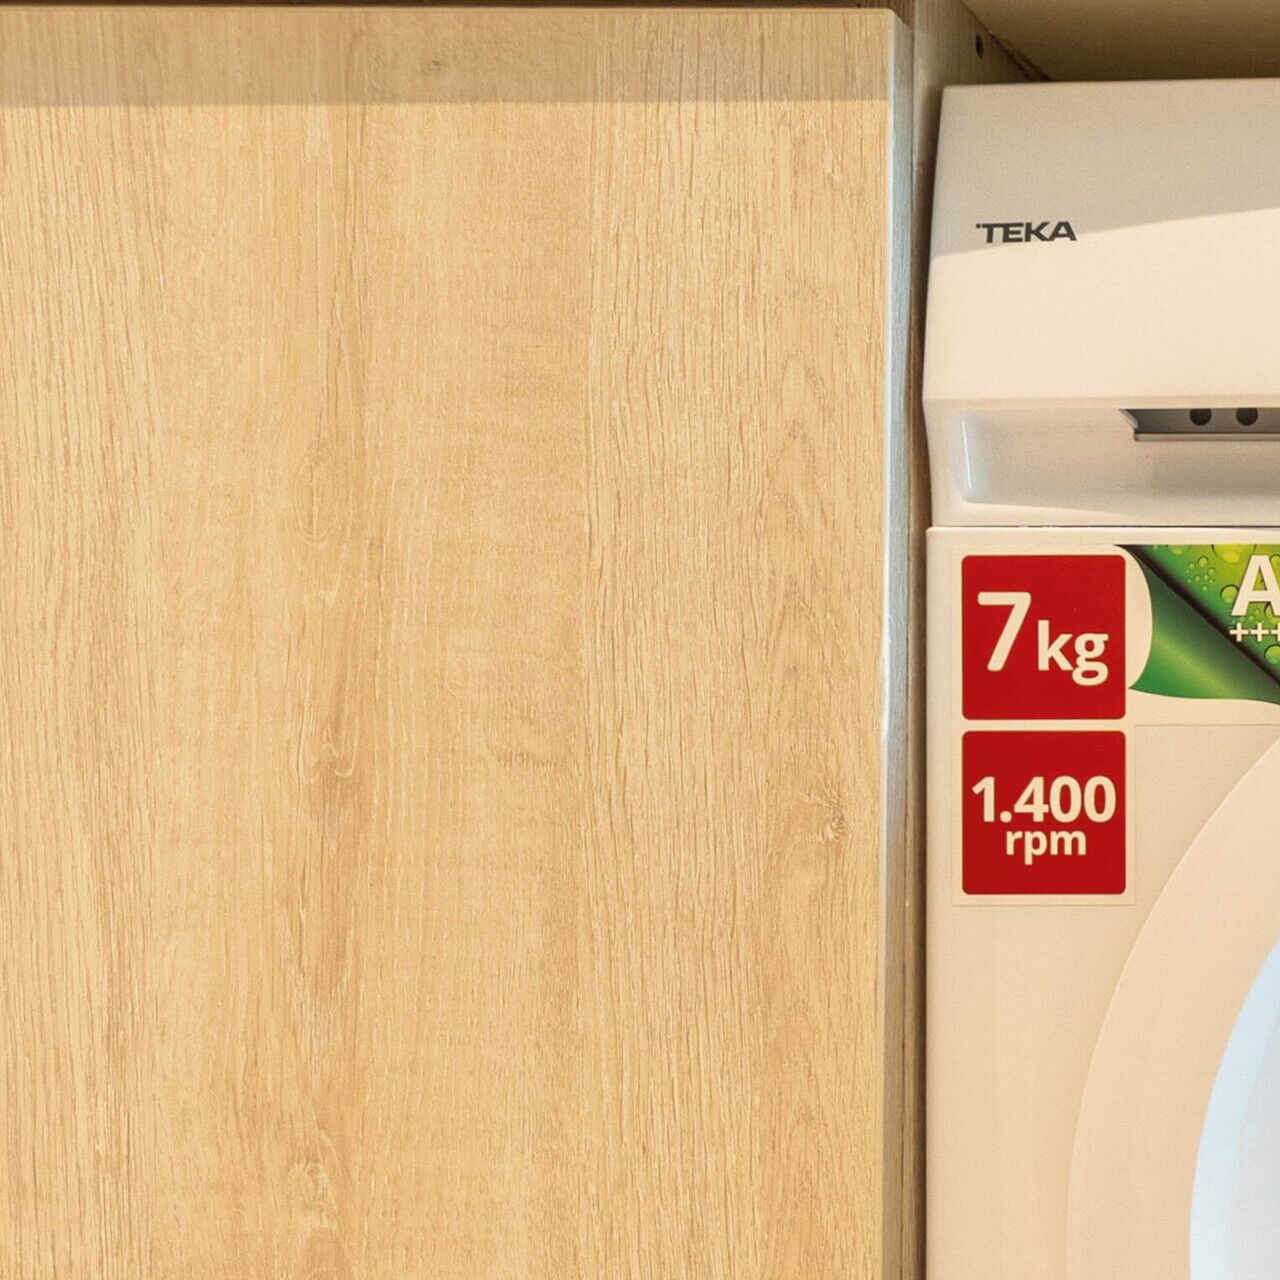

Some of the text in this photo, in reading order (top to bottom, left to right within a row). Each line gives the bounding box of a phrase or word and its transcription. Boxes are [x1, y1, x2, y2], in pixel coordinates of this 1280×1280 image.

[976, 220, 1077, 244] TEKA
[970, 774, 1117, 824] 1.400
[1005, 829, 1087, 866] rpm
